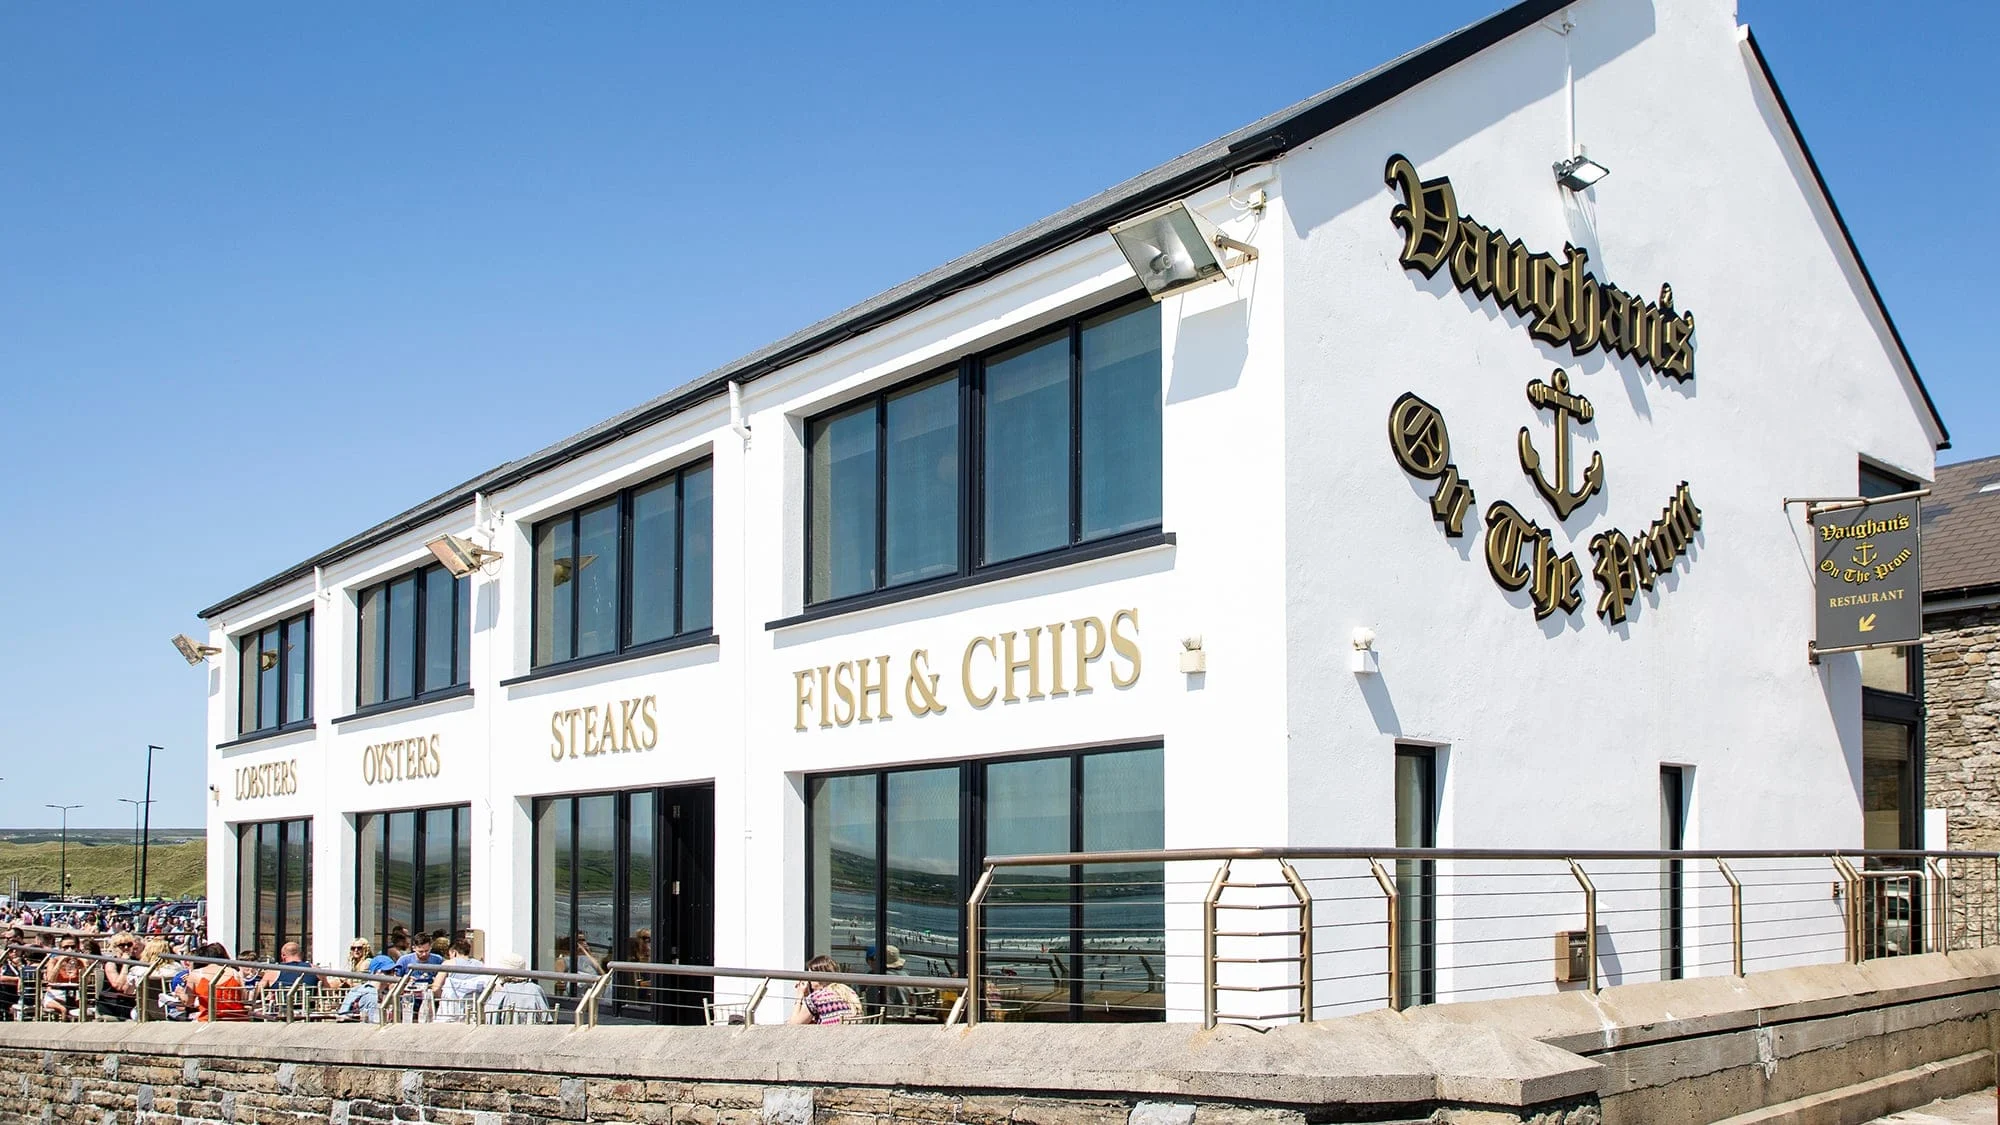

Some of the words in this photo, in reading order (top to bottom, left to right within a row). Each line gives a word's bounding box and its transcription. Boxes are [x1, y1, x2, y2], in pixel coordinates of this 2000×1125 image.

[1384, 153, 1695, 384] Vaughan's
[1388, 391, 1476, 538] On
[1484, 500, 1583, 621] The
[1588, 480, 1702, 625] Prom
[1820, 514, 1910, 541] Vaughan's
[1821, 559, 1840, 578] On
[1844, 568, 1870, 584] The
[1875, 548, 1912, 580] Prom
[1830, 589, 1904, 608] RESTAURANT
[793, 654, 893, 733] FISH
[905, 648, 947, 717] &
[961, 607, 1142, 711] CHIPS
[550, 694, 659, 762] STEAKS
[234, 758, 298, 801] LOBSTERS
[362, 733, 441, 786] OYSTERS
